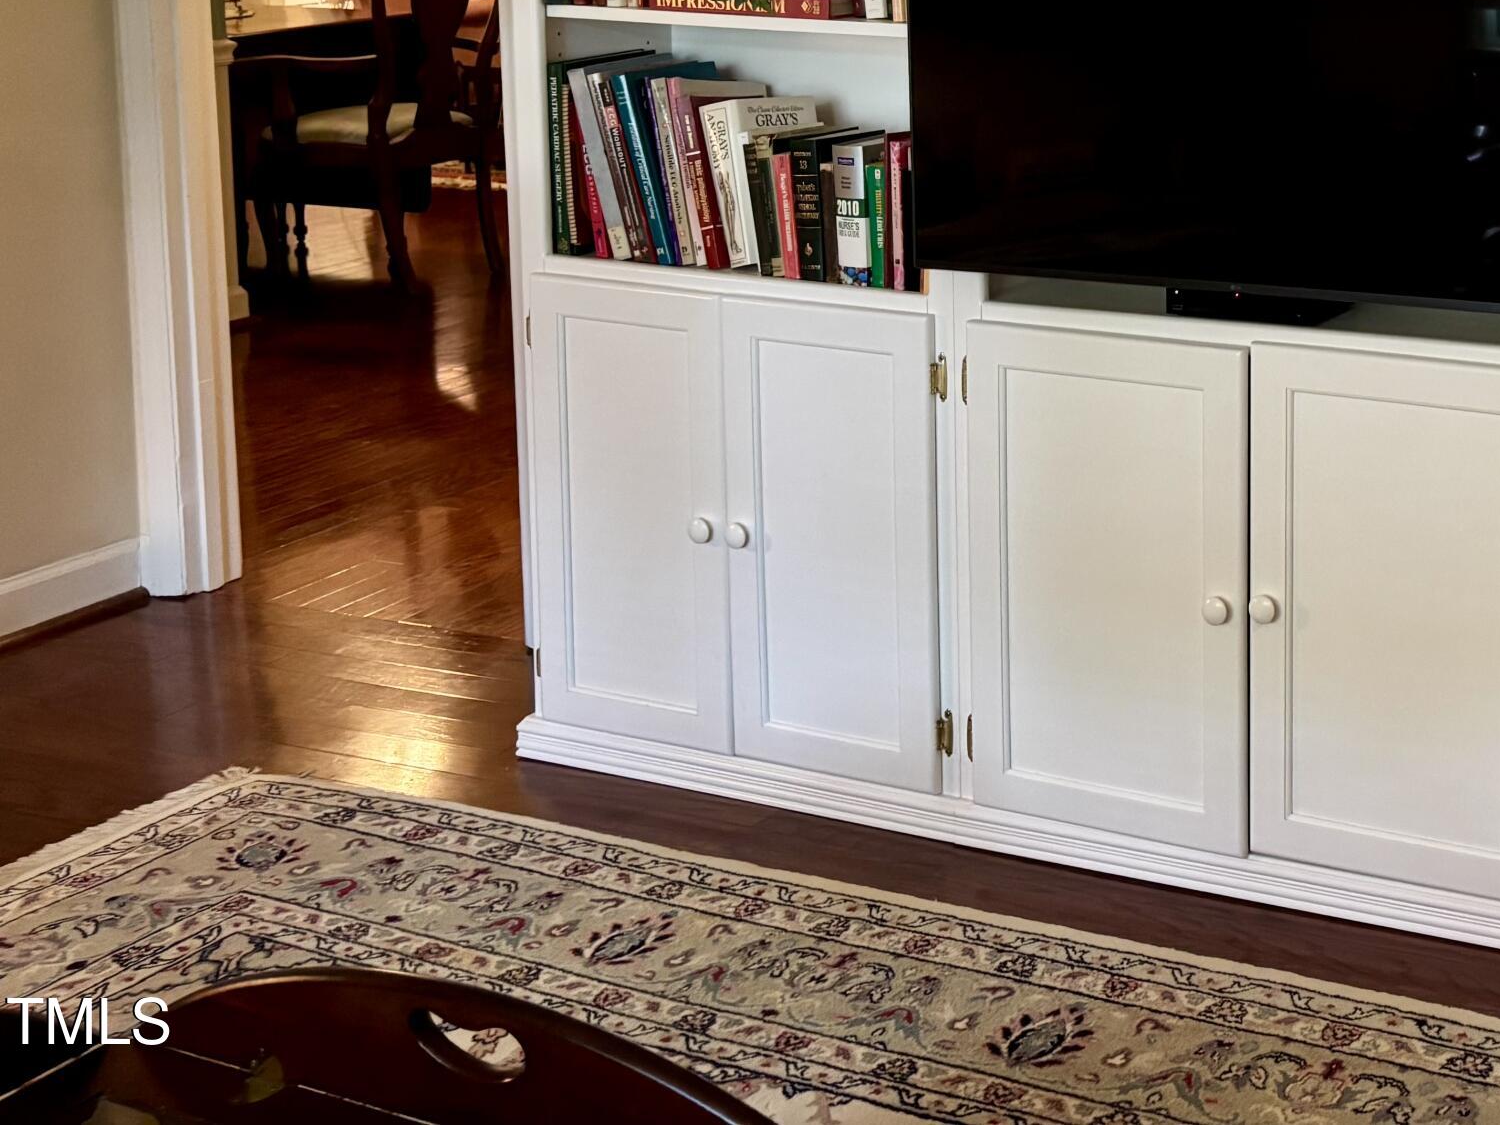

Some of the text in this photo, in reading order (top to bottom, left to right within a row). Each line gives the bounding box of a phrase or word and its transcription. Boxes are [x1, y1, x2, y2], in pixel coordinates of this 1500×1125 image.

[550, 76, 558, 123] PEDIATRIC
[606, 107, 627, 169] ECG WORKOUT
[755, 113, 799, 127] GRAY'S
[552, 125, 561, 163] CARDIAC
[661, 135, 676, 170] Sensible
[717, 120, 729, 161] GRAY'S
[636, 157, 657, 220] Critical Care Nursing
[669, 170, 680, 189] ECG
[693, 159, 712, 223] Basic pathophysiology
[671, 189, 686, 225] Analysis
[836, 200, 860, 216] 2010
[838, 222, 860, 231] NURSE'S
